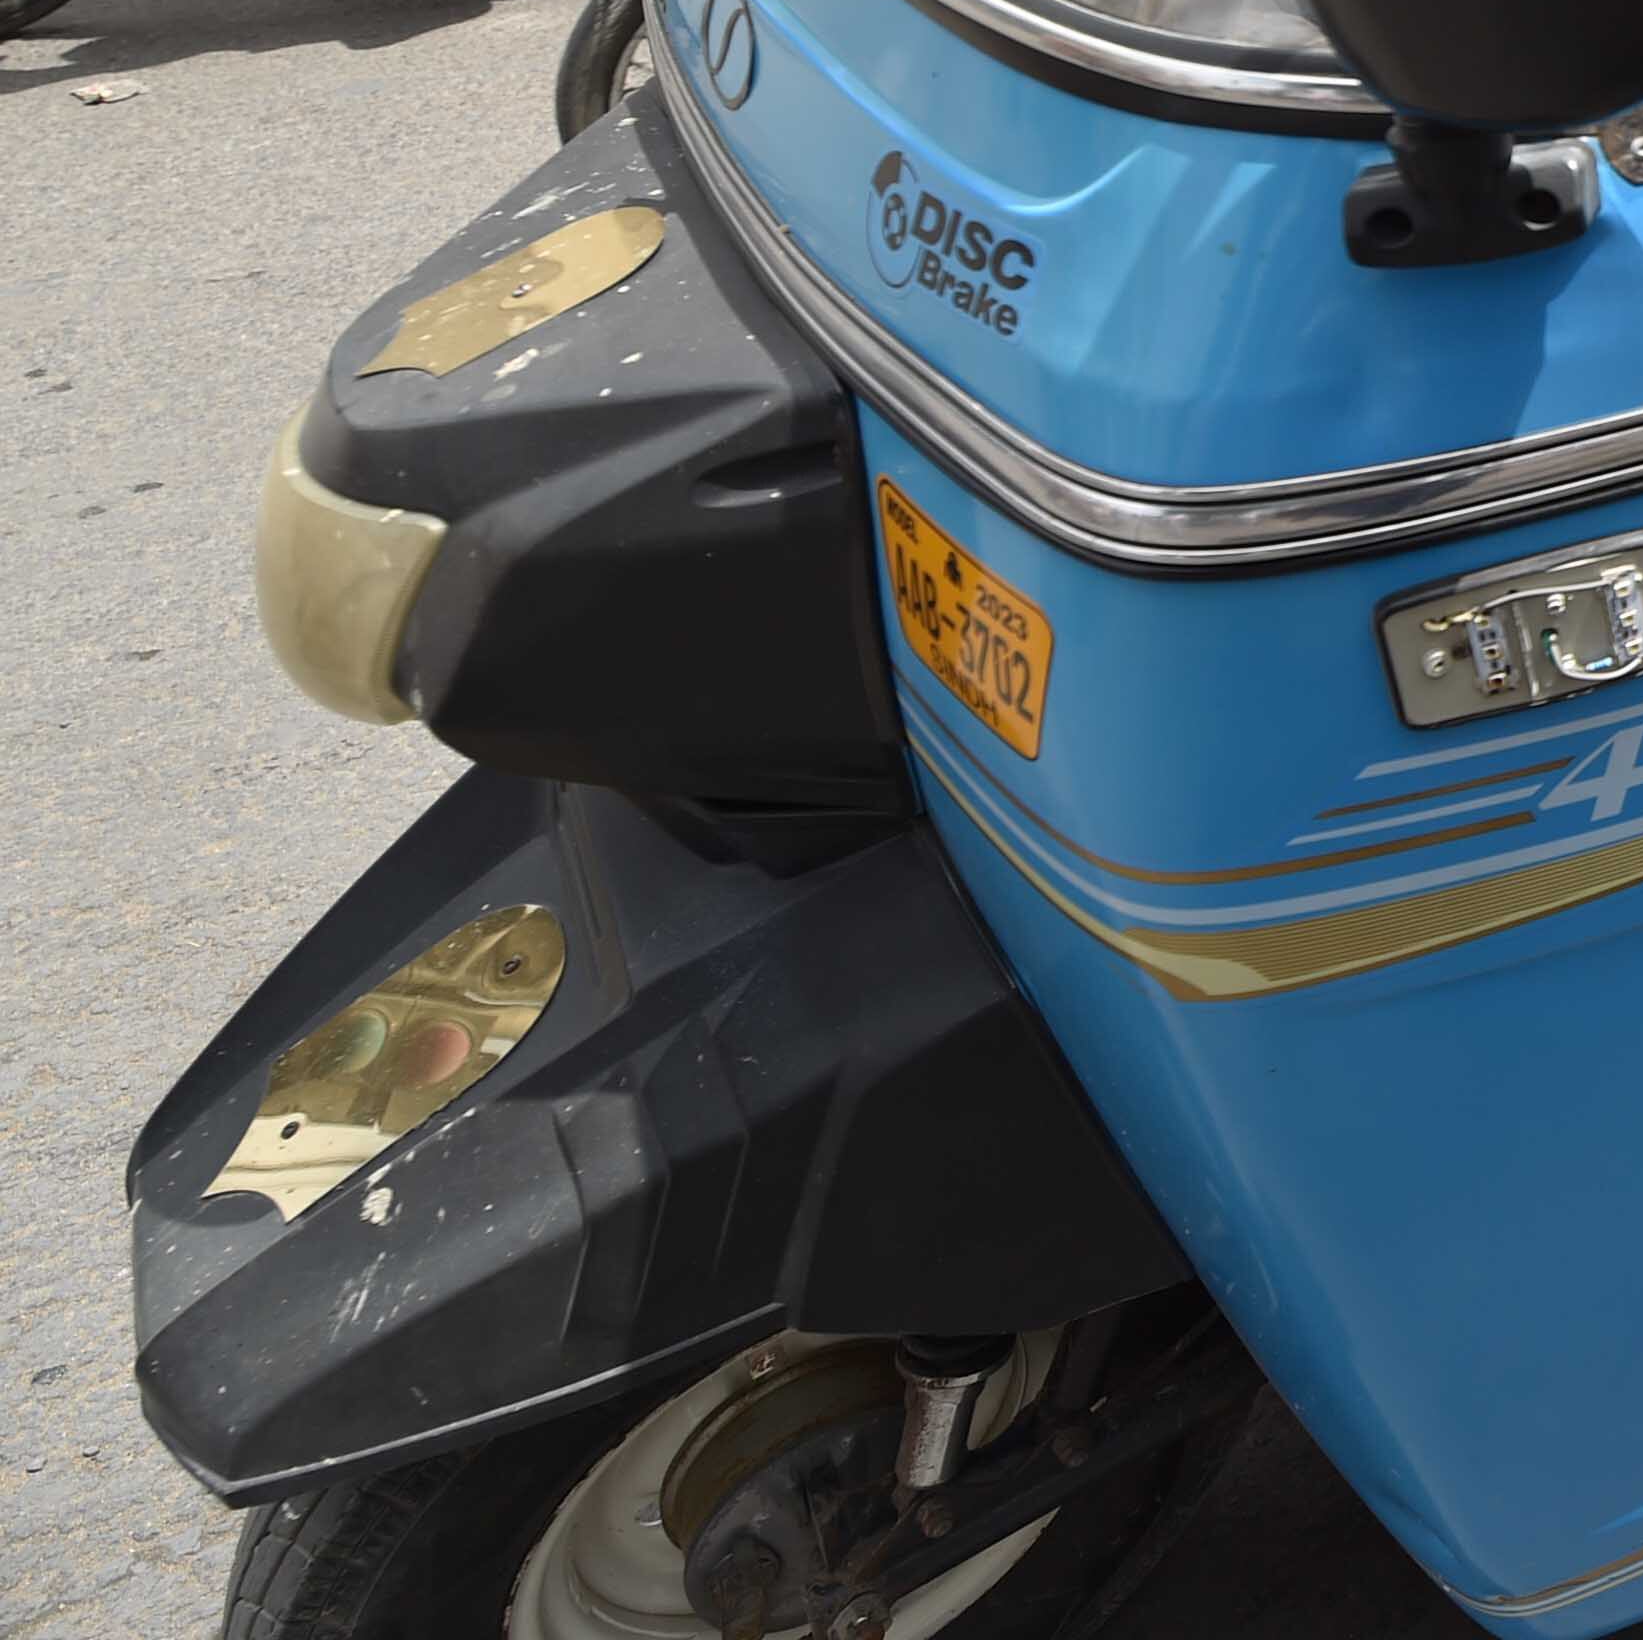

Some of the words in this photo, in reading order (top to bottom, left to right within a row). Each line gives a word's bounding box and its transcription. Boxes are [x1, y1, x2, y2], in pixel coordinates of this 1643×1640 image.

[911, 190, 1036, 291] DISC
[916, 248, 1018, 336] Brake
[885, 496, 919, 545] MODEL
[976, 582, 1028, 641] 2023
[896, 543, 1034, 724] AAB-3702
[929, 642, 999, 726] SINDH
